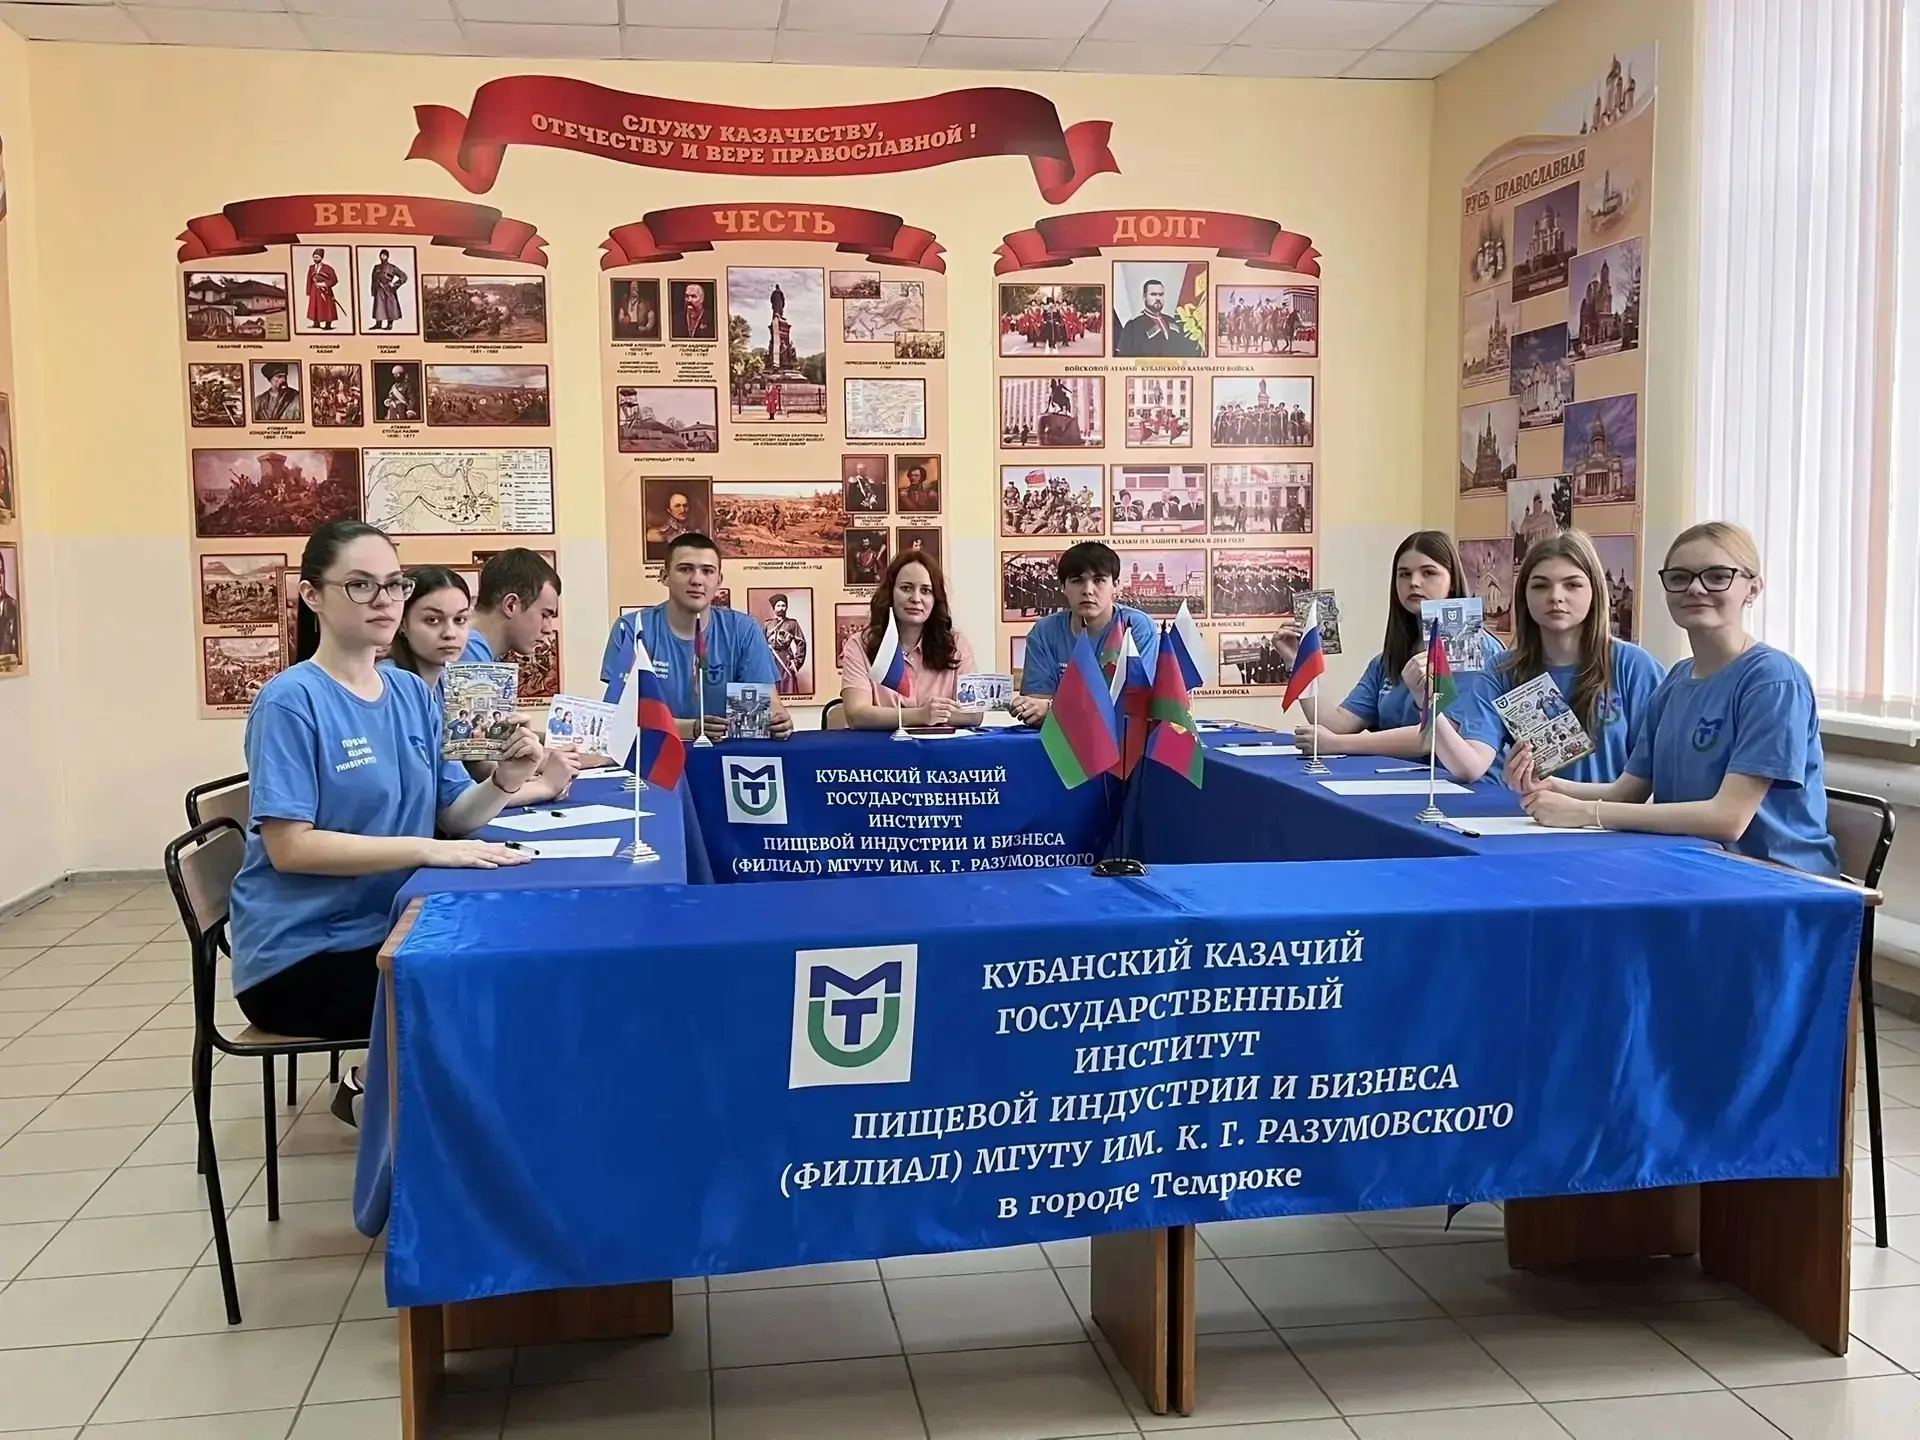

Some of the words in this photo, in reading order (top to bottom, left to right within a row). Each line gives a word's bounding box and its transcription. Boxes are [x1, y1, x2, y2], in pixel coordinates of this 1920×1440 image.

[531, 113, 675, 157] ОТЕЧЕСТВУ
[681, 143, 699, 160] И
[706, 145, 765, 164] ВЕРЕ
[772, 124, 962, 164] ПРАВОСЛАВНОЙ
[970, 123, 977, 139] !
[622, 114, 713, 141] СЛУЖУ
[719, 122, 884, 144] КАЗАЧЕСТВУ,
[1464, 190, 1490, 214] РУСЬ
[1494, 149, 1586, 203] ПРАВОСЛАВНАЯ
[314, 203, 416, 228] ВЕРА
[713, 209, 836, 235] ЧЕСТЬ
[1113, 216, 1207, 243] ДОЛГ
[815, 767, 921, 784] КУБАНСКИЙ
[926, 765, 1007, 784] КАЗАЧИЙ
[826, 787, 1000, 806] ГОСУДАРСТВЕННЫЙ
[868, 814, 963, 829] ИНСТИТУТ
[763, 833, 855, 852] ПИЩЕВОЙ
[861, 836, 968, 853] ИНДУСТРИИ
[973, 836, 986, 849] И
[991, 833, 1065, 849] БИЗНЕСА
[732, 857, 823, 875] (ФИЛИАЛ)
[827, 858, 884, 873] МГУТУ
[889, 859, 923, 873] ИМ.
[930, 859, 946, 873] К.
[951, 859, 965, 873] Г.
[970, 853, 1095, 870] РАЗУМОВСКОГО
[981, 937, 1192, 990] КУБАНСКИЙ
[1204, 929, 1364, 968] КАЗАЧИЙ
[995, 976, 1344, 1035] ГОСУДАРСТВЕННЫЙ
[1073, 1031, 1260, 1074] ИНСТИТУТ
[851, 1090, 1039, 1139] ПИЩЕВОЙ
[1049, 1075, 1260, 1124] ИНДУСТРИИ
[1270, 1075, 1298, 1100] И
[1308, 1063, 1459, 1100] БИЗНЕСА
[779, 1150, 963, 1198] (ФИЛИАЛ)
[973, 1140, 1093, 1175] МГУТУ
[1101, 1129, 1164, 1164] ИМ.
[1175, 1125, 1208, 1151] К.
[1219, 1121, 1245, 1148] Г.
[1256, 1102, 1514, 1145] РАЗУМОВСКОГО
[997, 1197, 1018, 1219] в
[1029, 1181, 1140, 1218] городе
[1150, 1166, 1302, 1202] Темрюке
